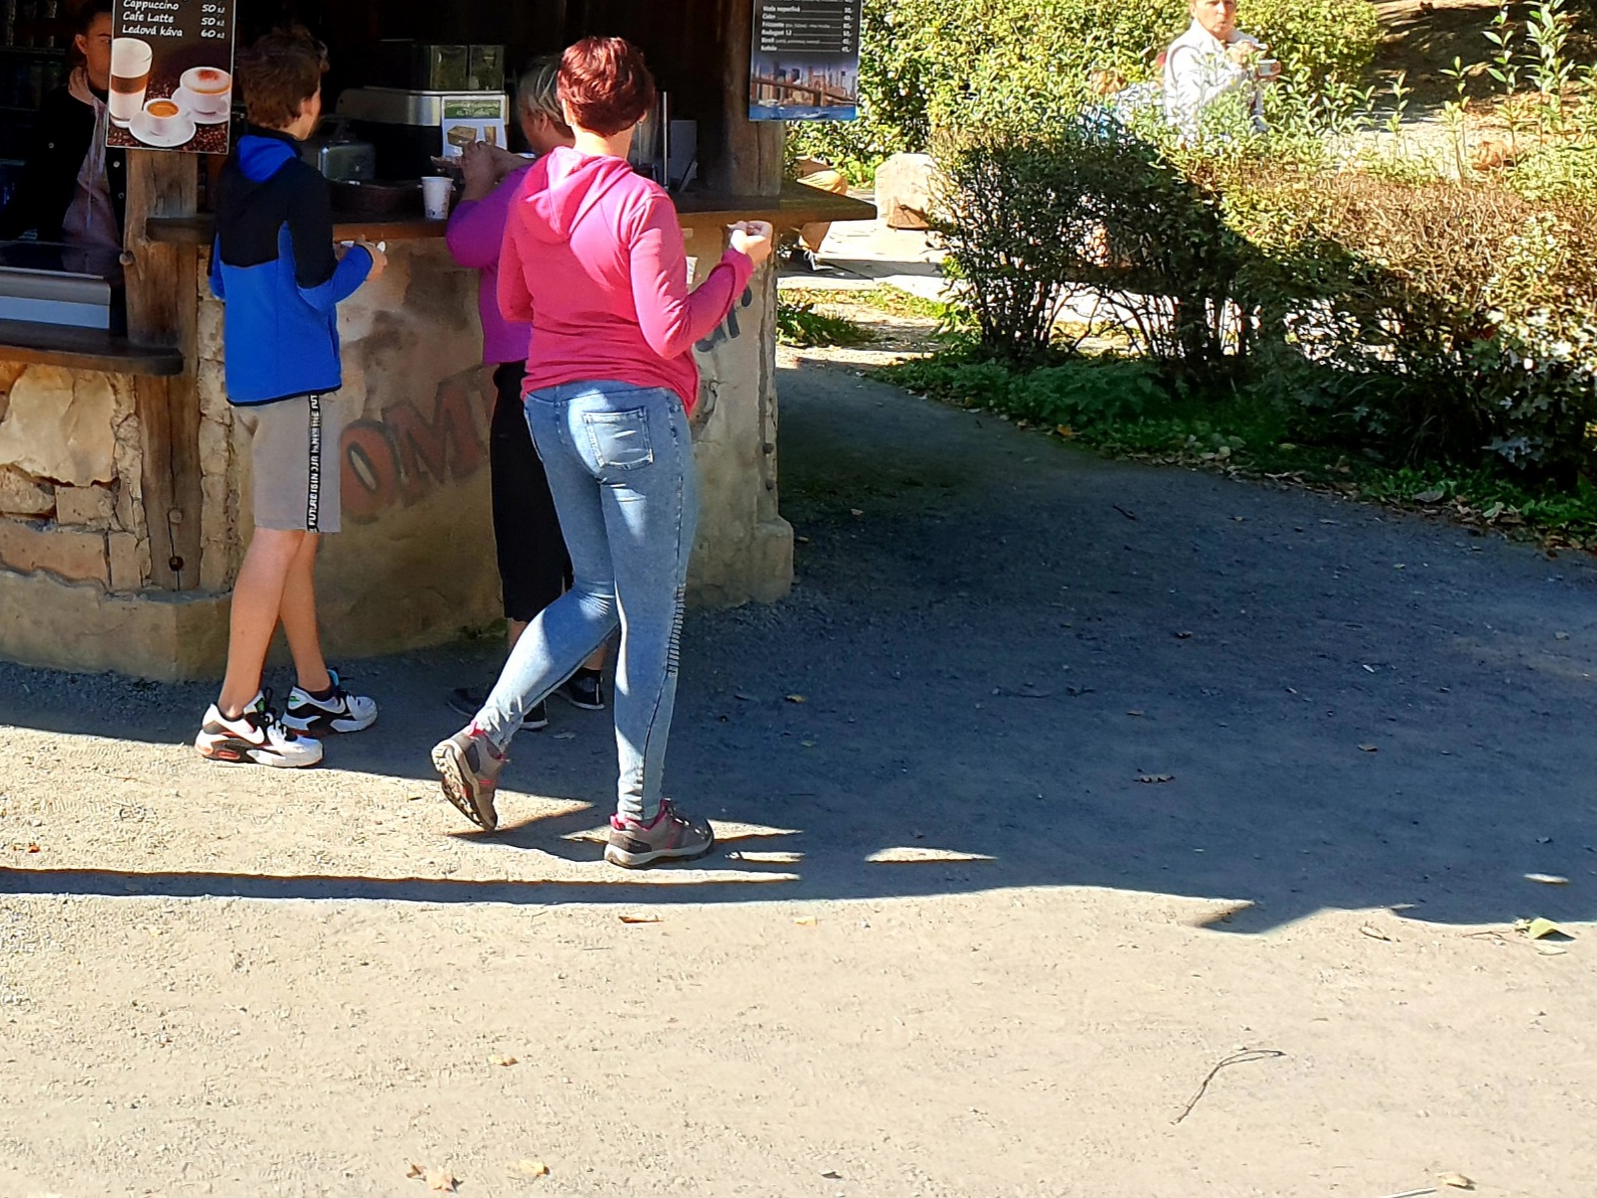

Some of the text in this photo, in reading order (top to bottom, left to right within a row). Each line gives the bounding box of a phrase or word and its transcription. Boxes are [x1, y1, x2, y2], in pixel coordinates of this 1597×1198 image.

[201, 4, 217, 13] 50
[123, 11, 144, 21] Cafe
[147, 13, 174, 23] Latte
[200, 17, 216, 26] 50
[122, 24, 157, 35] Ledová
[160, 25, 183, 37] káva
[200, 29, 216, 38] 60
